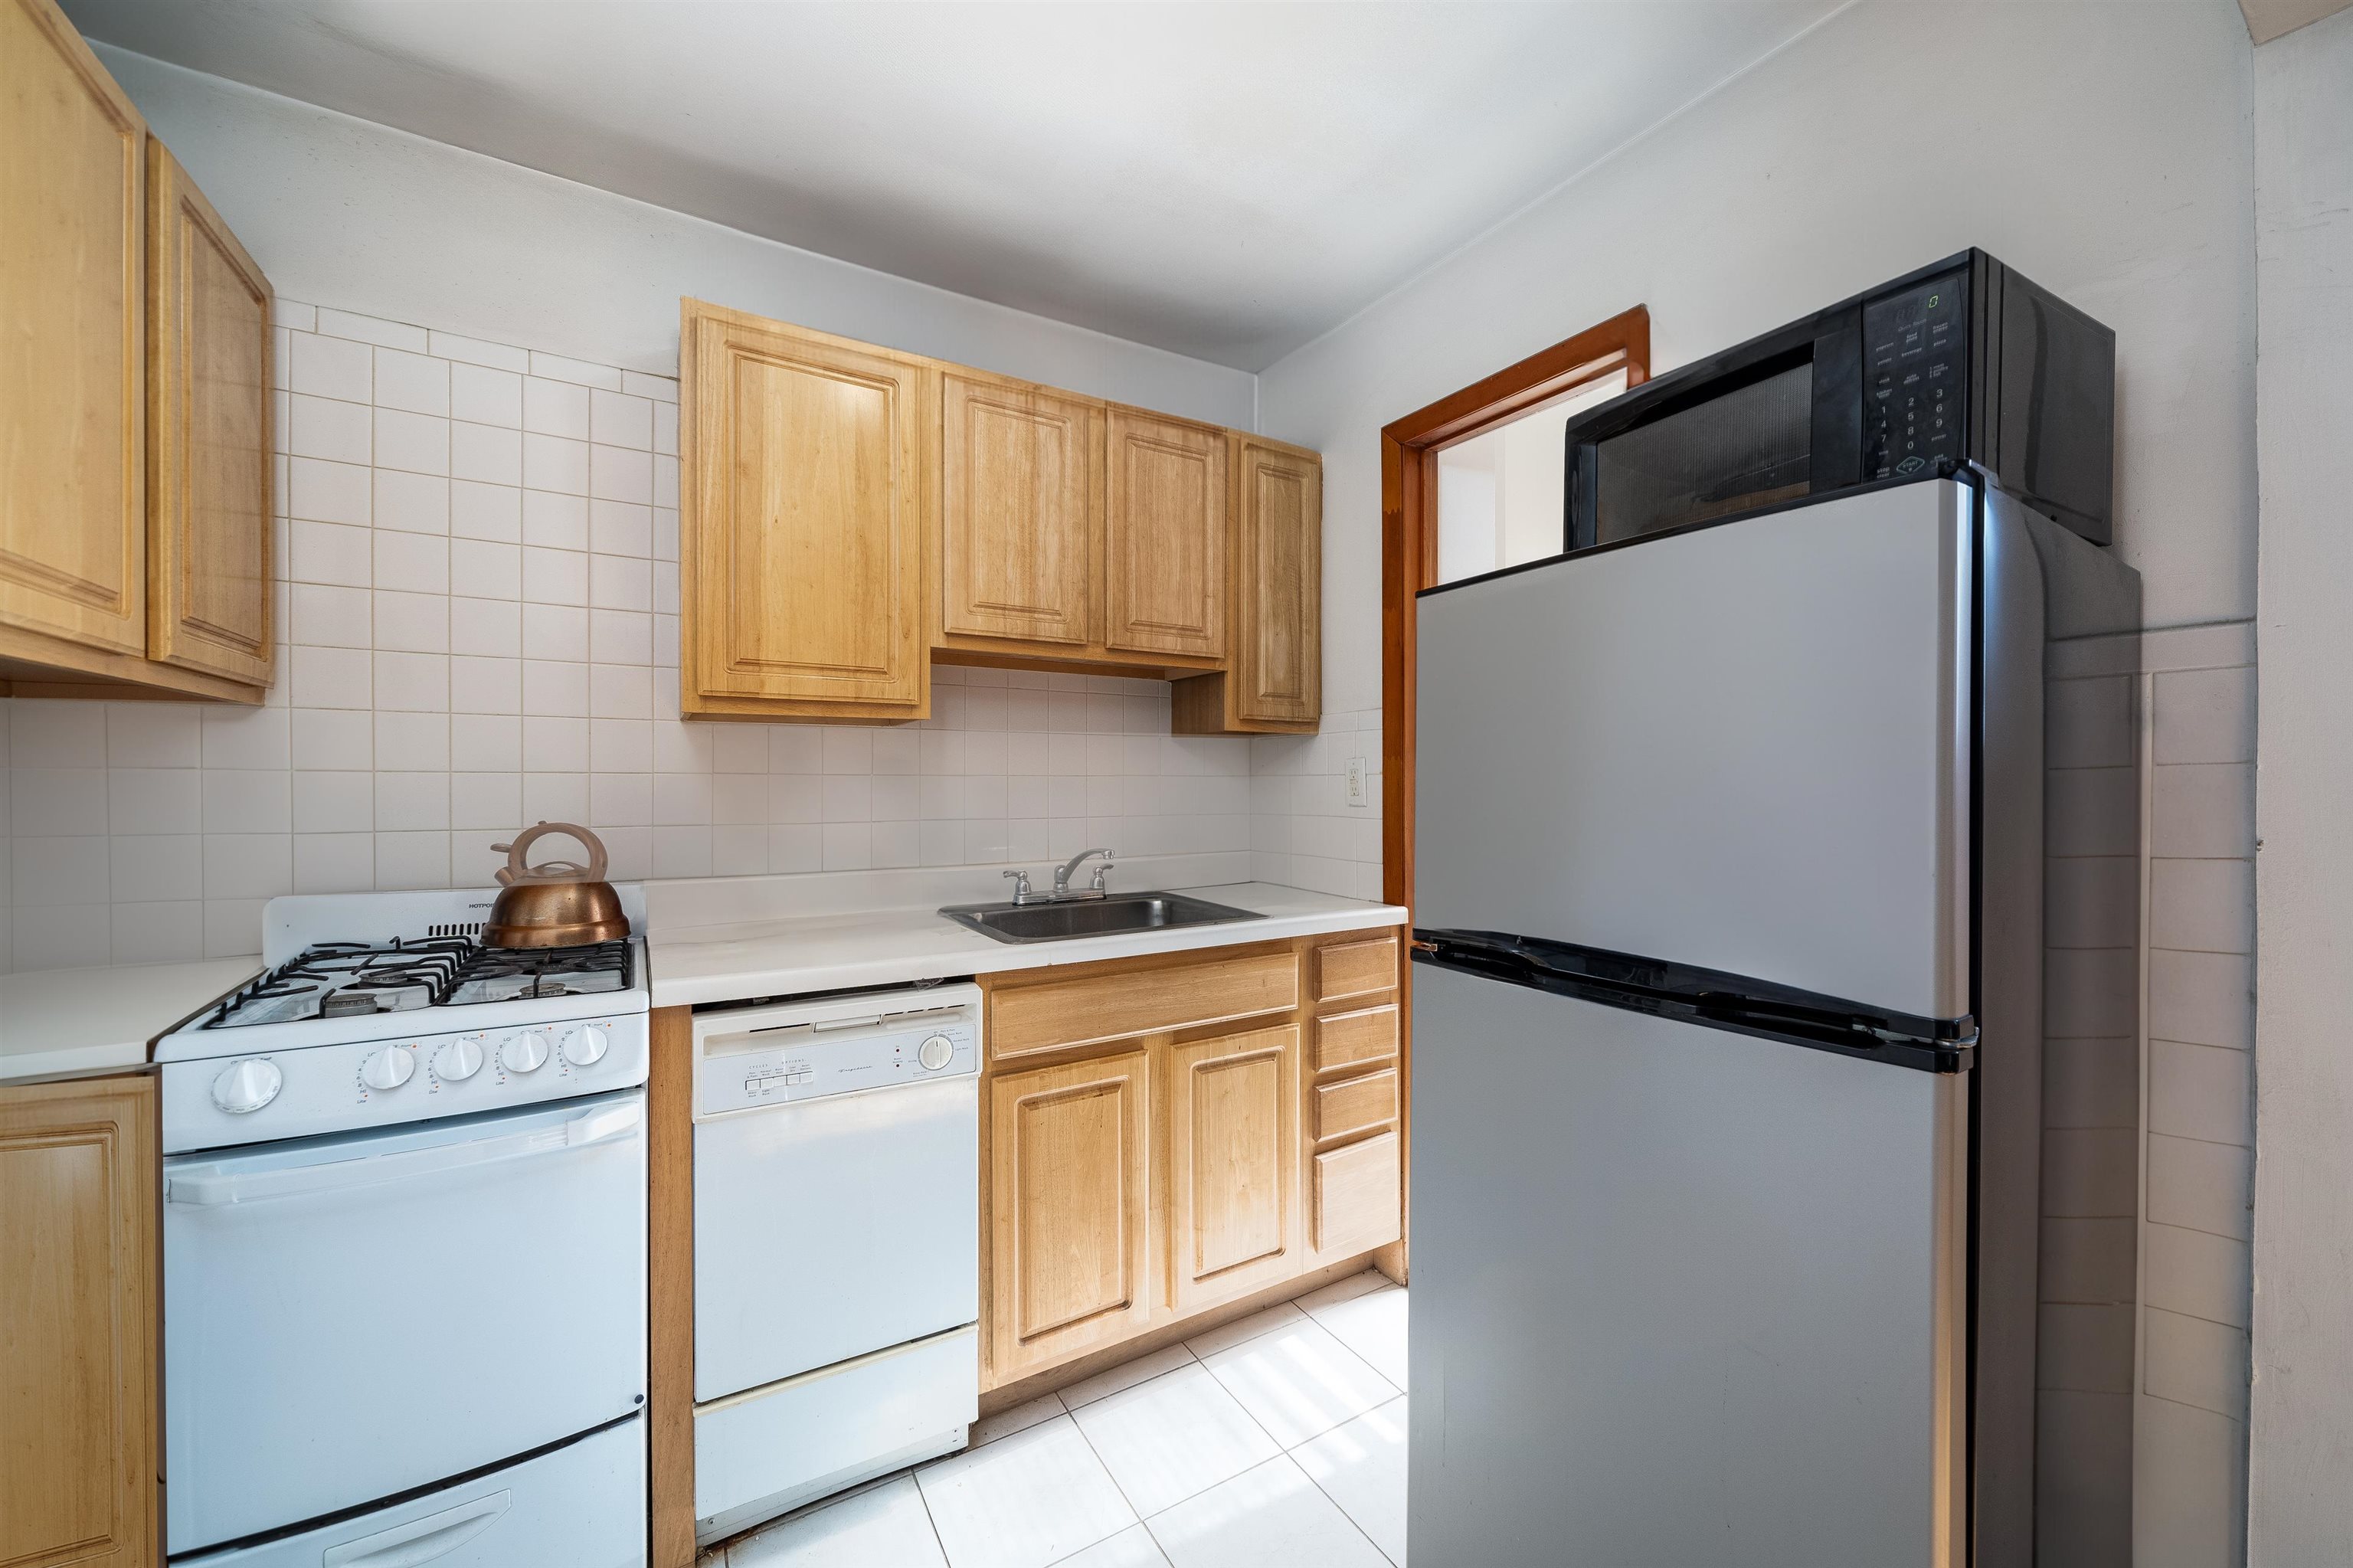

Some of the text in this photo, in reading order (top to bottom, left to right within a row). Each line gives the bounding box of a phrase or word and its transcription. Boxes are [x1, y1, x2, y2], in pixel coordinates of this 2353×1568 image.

[1929, 295, 1939, 308] 0
[1936, 388, 1943, 398] 3
[1908, 397, 1914, 407] 2
[1881, 405, 1886, 414] 1
[1936, 403, 1943, 414] 6
[1907, 411, 1914, 421] 5
[1880, 420, 1887, 428] 4
[1936, 418, 1943, 428] 9
[1907, 426, 1914, 436] 8
[1881, 434, 1887, 443] 7
[1907, 440, 1914, 450] 0
[1902, 460, 1919, 469] START
